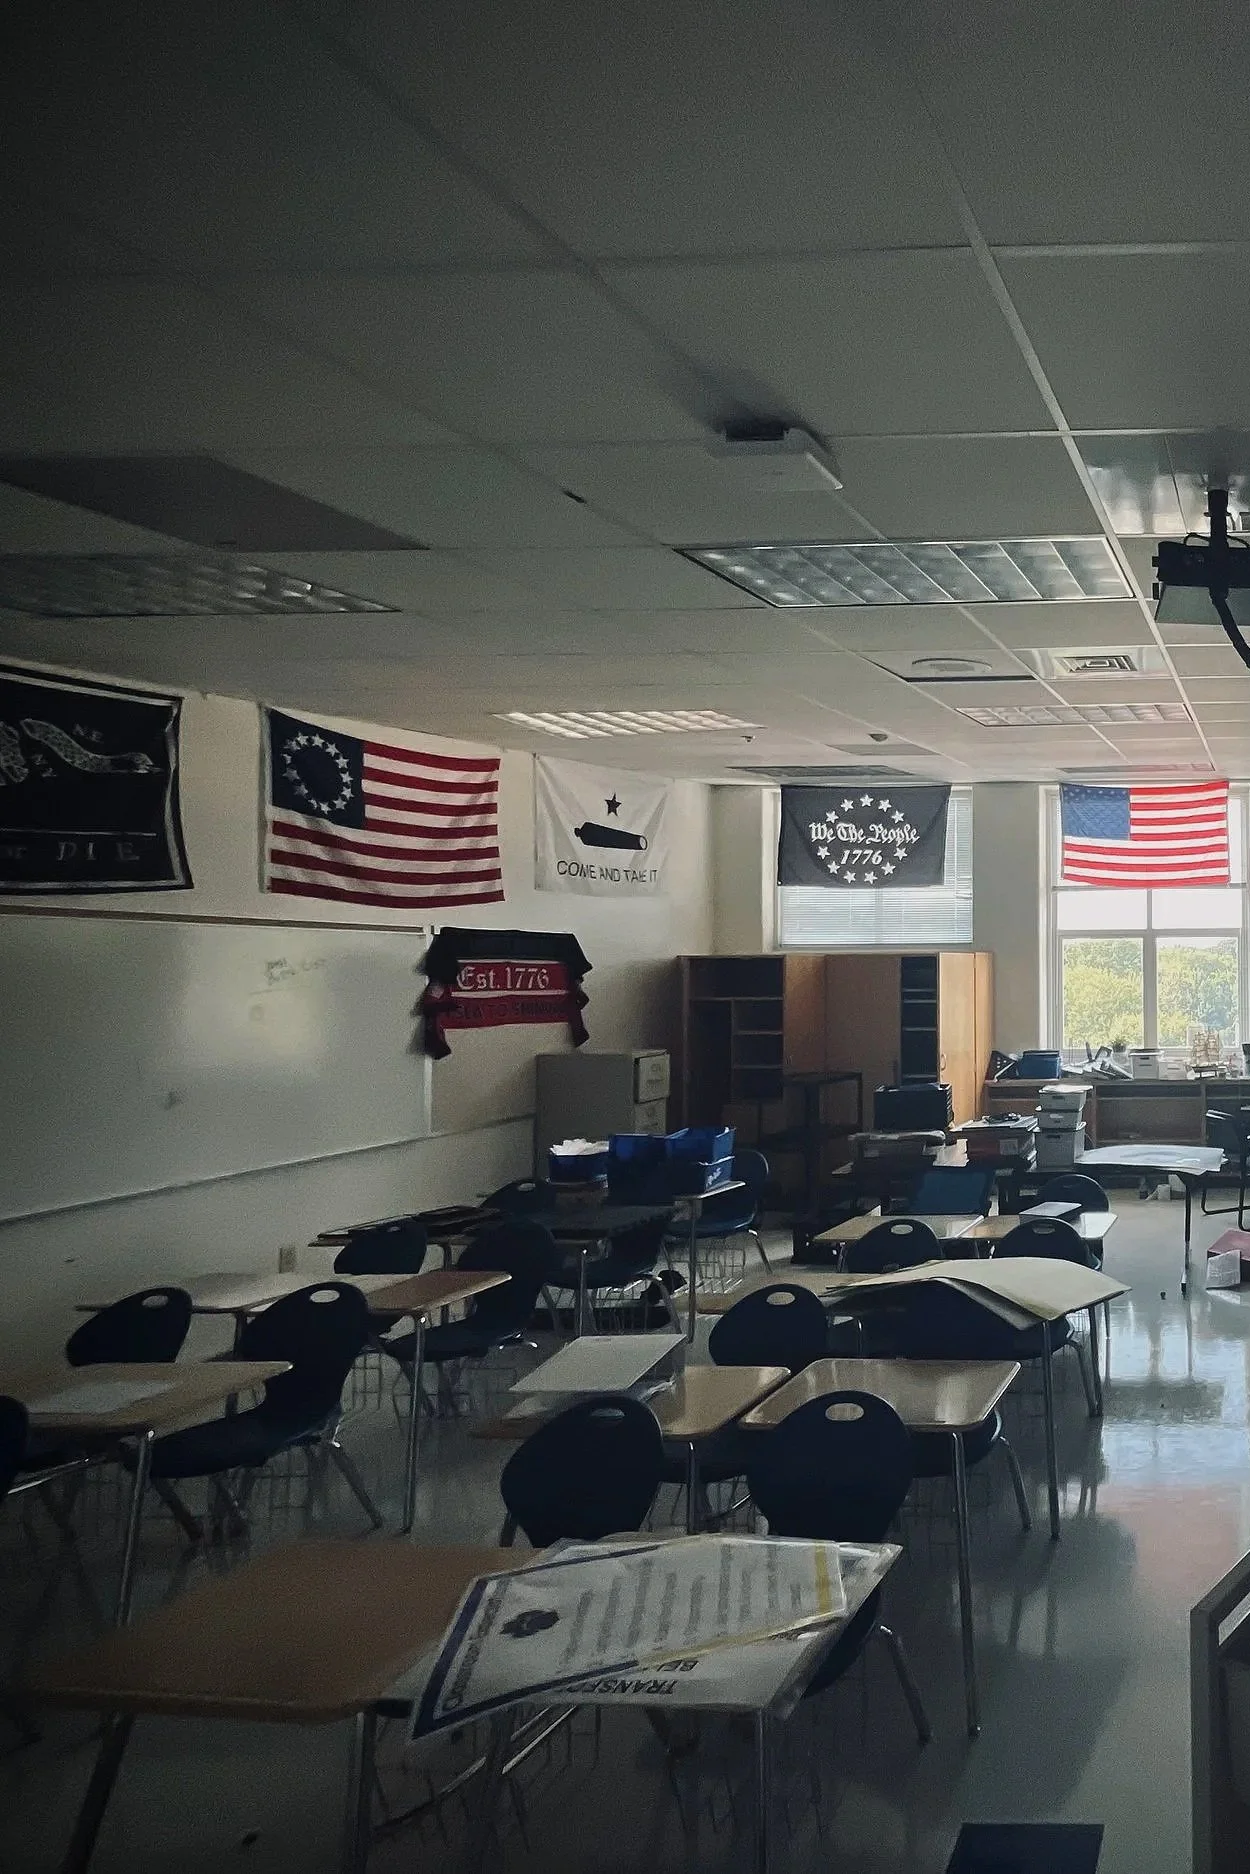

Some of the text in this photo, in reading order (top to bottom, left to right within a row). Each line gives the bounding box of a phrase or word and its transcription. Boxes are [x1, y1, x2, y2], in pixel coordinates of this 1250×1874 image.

[808, 821, 920, 847] We The People
[56, 841, 140, 861] DIE
[840, 849, 883, 865] 1776
[600, 867, 621, 882] AND
[457, 966, 550, 990] Est. 1776
